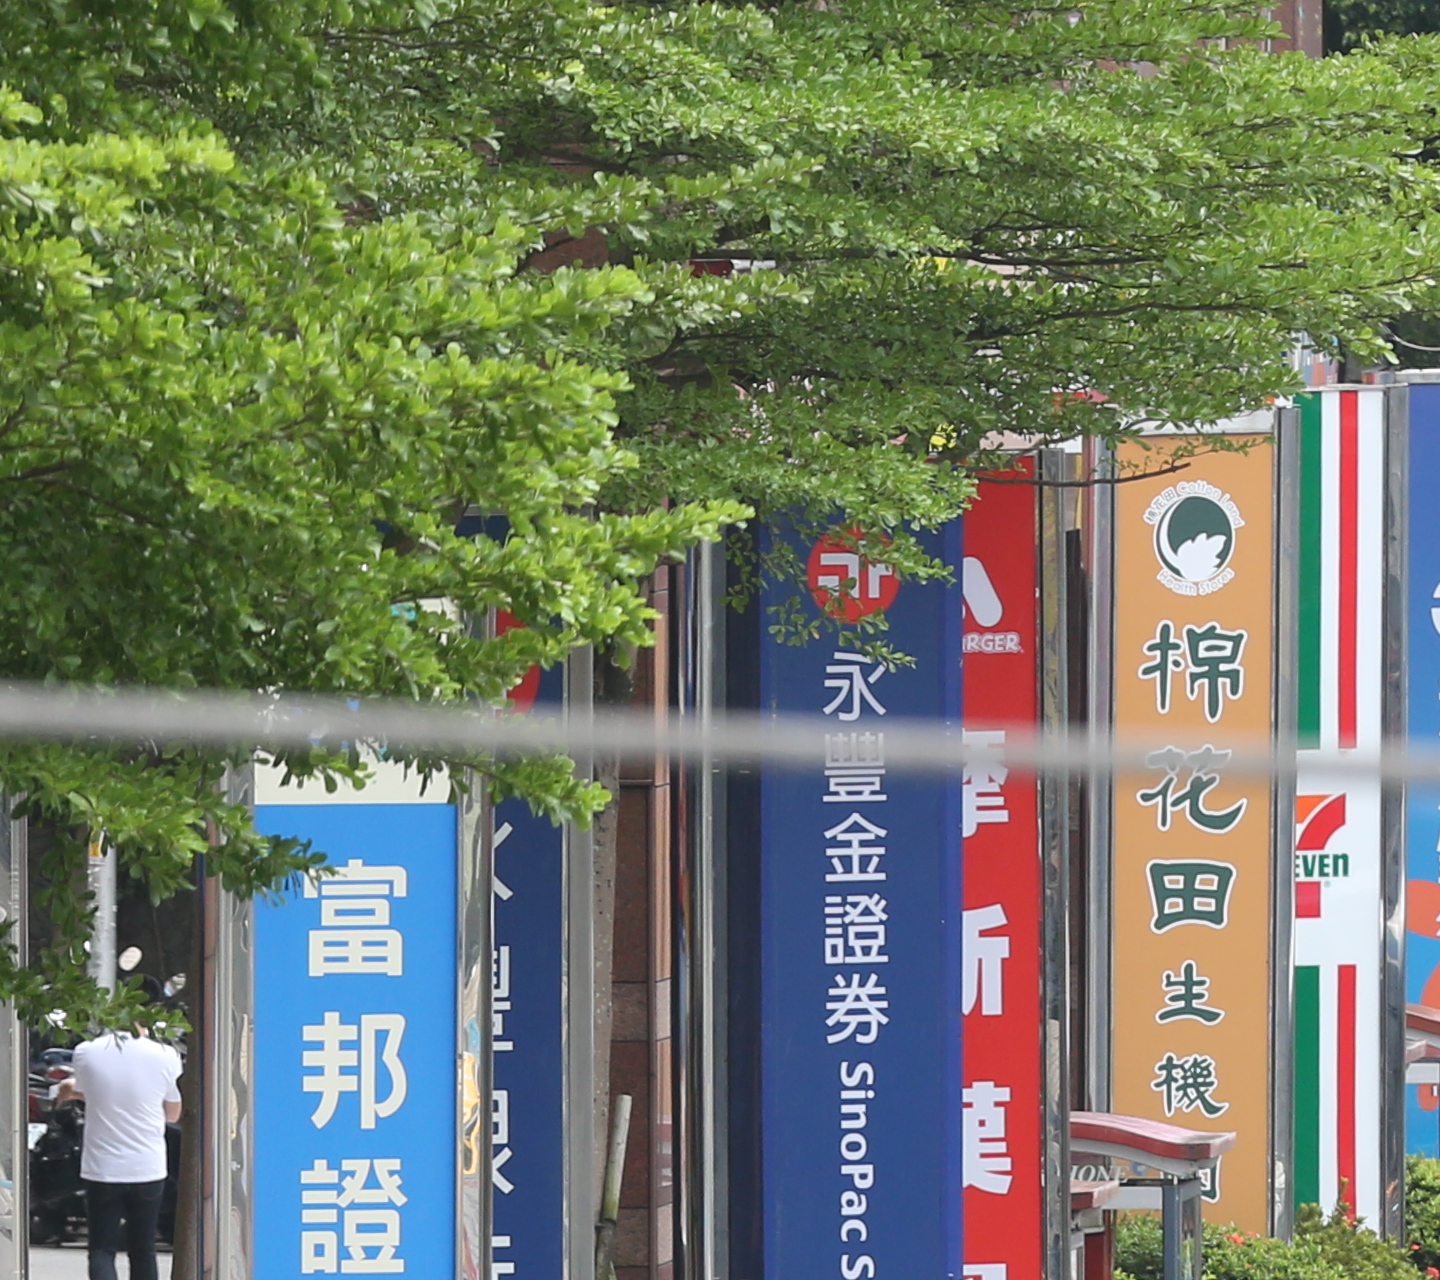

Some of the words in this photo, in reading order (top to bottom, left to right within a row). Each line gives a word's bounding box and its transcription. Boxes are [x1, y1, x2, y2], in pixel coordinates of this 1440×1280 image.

[822, 651, 889, 1046] 永豐金證券
[1137, 619, 1247, 1202] 棉花田生機
[839, 1061, 876, 1243] SinoPac
